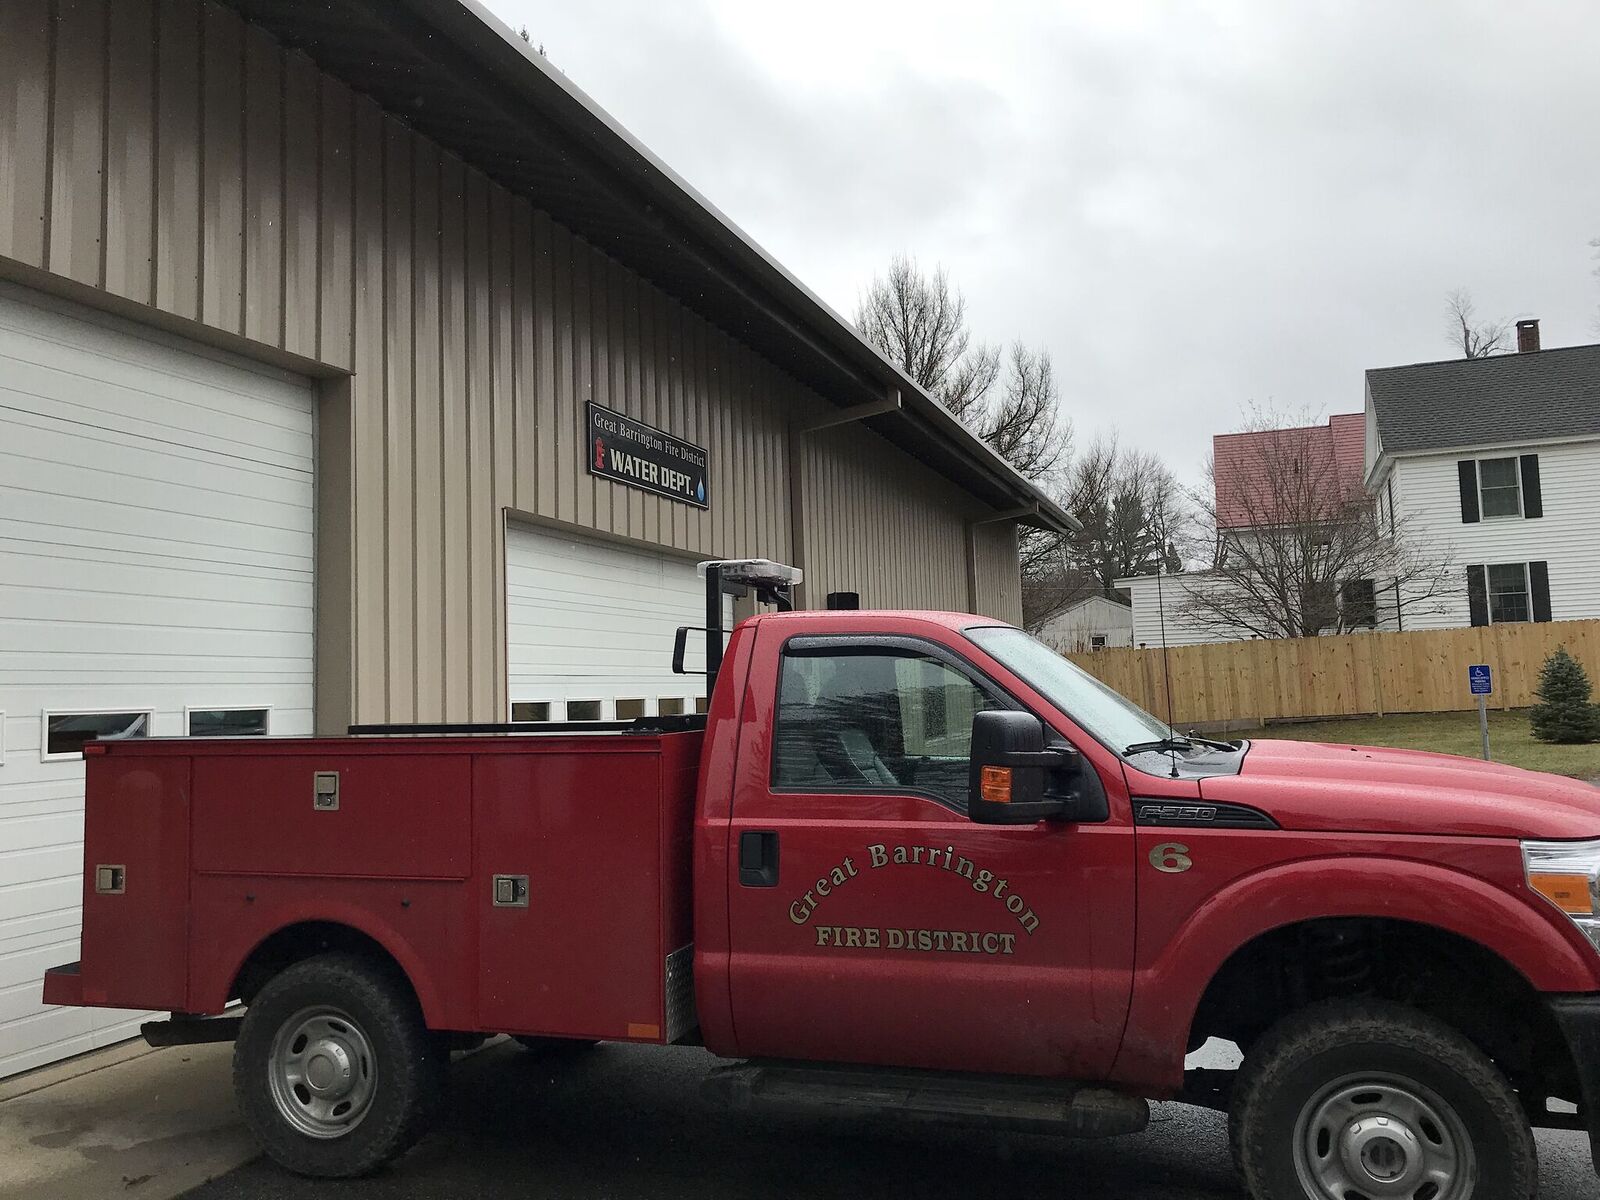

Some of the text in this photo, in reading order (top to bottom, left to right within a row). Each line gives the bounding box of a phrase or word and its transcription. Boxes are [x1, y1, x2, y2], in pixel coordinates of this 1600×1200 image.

[594, 412, 705, 468] Great Barrington Fire District
[610, 448, 694, 496] WATER DEPT.
[1148, 842, 1193, 873] 6
[788, 843, 1041, 935] Great Barrington
[815, 926, 1016, 954] FIRE DISTRICT
